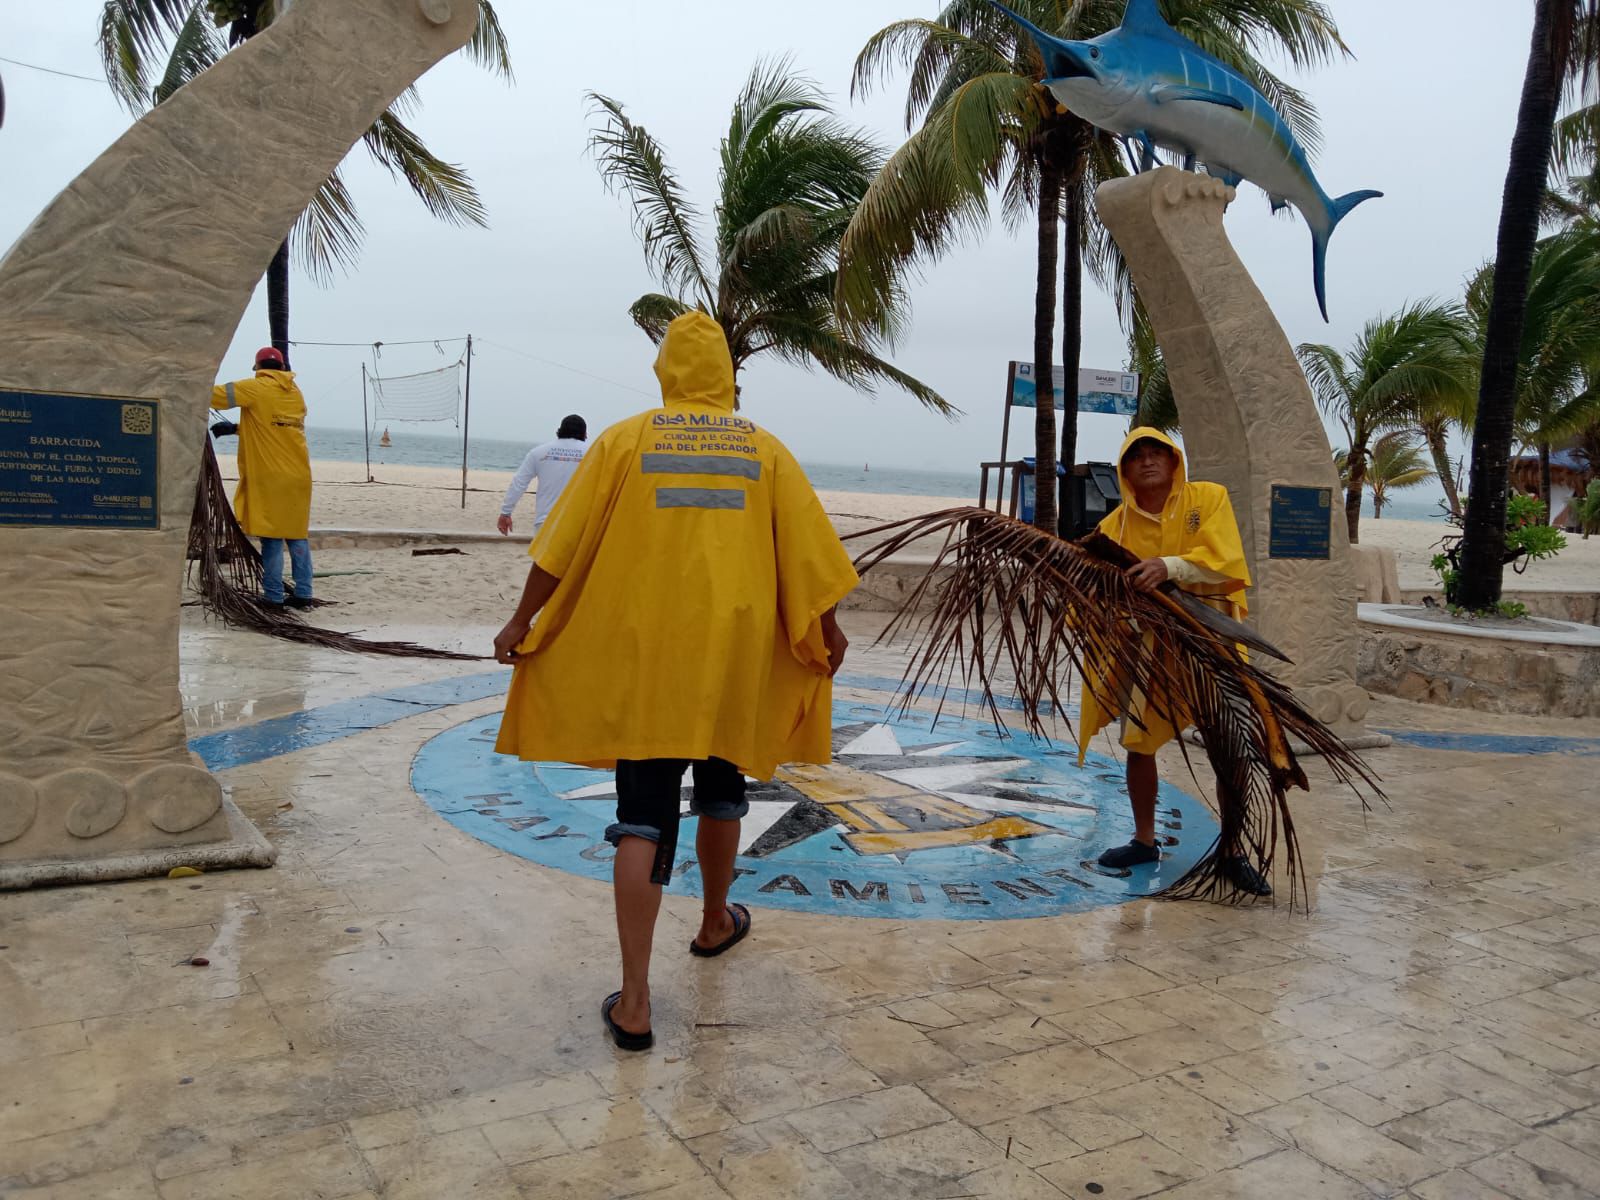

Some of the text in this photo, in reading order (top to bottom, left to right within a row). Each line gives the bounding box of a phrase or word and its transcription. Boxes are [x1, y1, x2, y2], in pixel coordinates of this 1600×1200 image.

[653, 413, 687, 426] ISLA
[30, 436, 102, 449] BARRACUDA
[664, 433, 698, 442] CUIDAR
[720, 434, 749, 444] GENTE
[655, 442, 758, 455] DIA DEL PESCADOR
[33, 452, 45, 460] EN
[49, 453, 60, 461] EL
[64, 454, 93, 462] CLIMA
[95, 455, 138, 465] TROPICAL
[64, 465, 94, 474] FUERA
[97, 466, 104, 474] Y
[107, 467, 142, 476] DENTRO
[30, 474, 43, 482] DE
[47, 475, 64, 483] LAS
